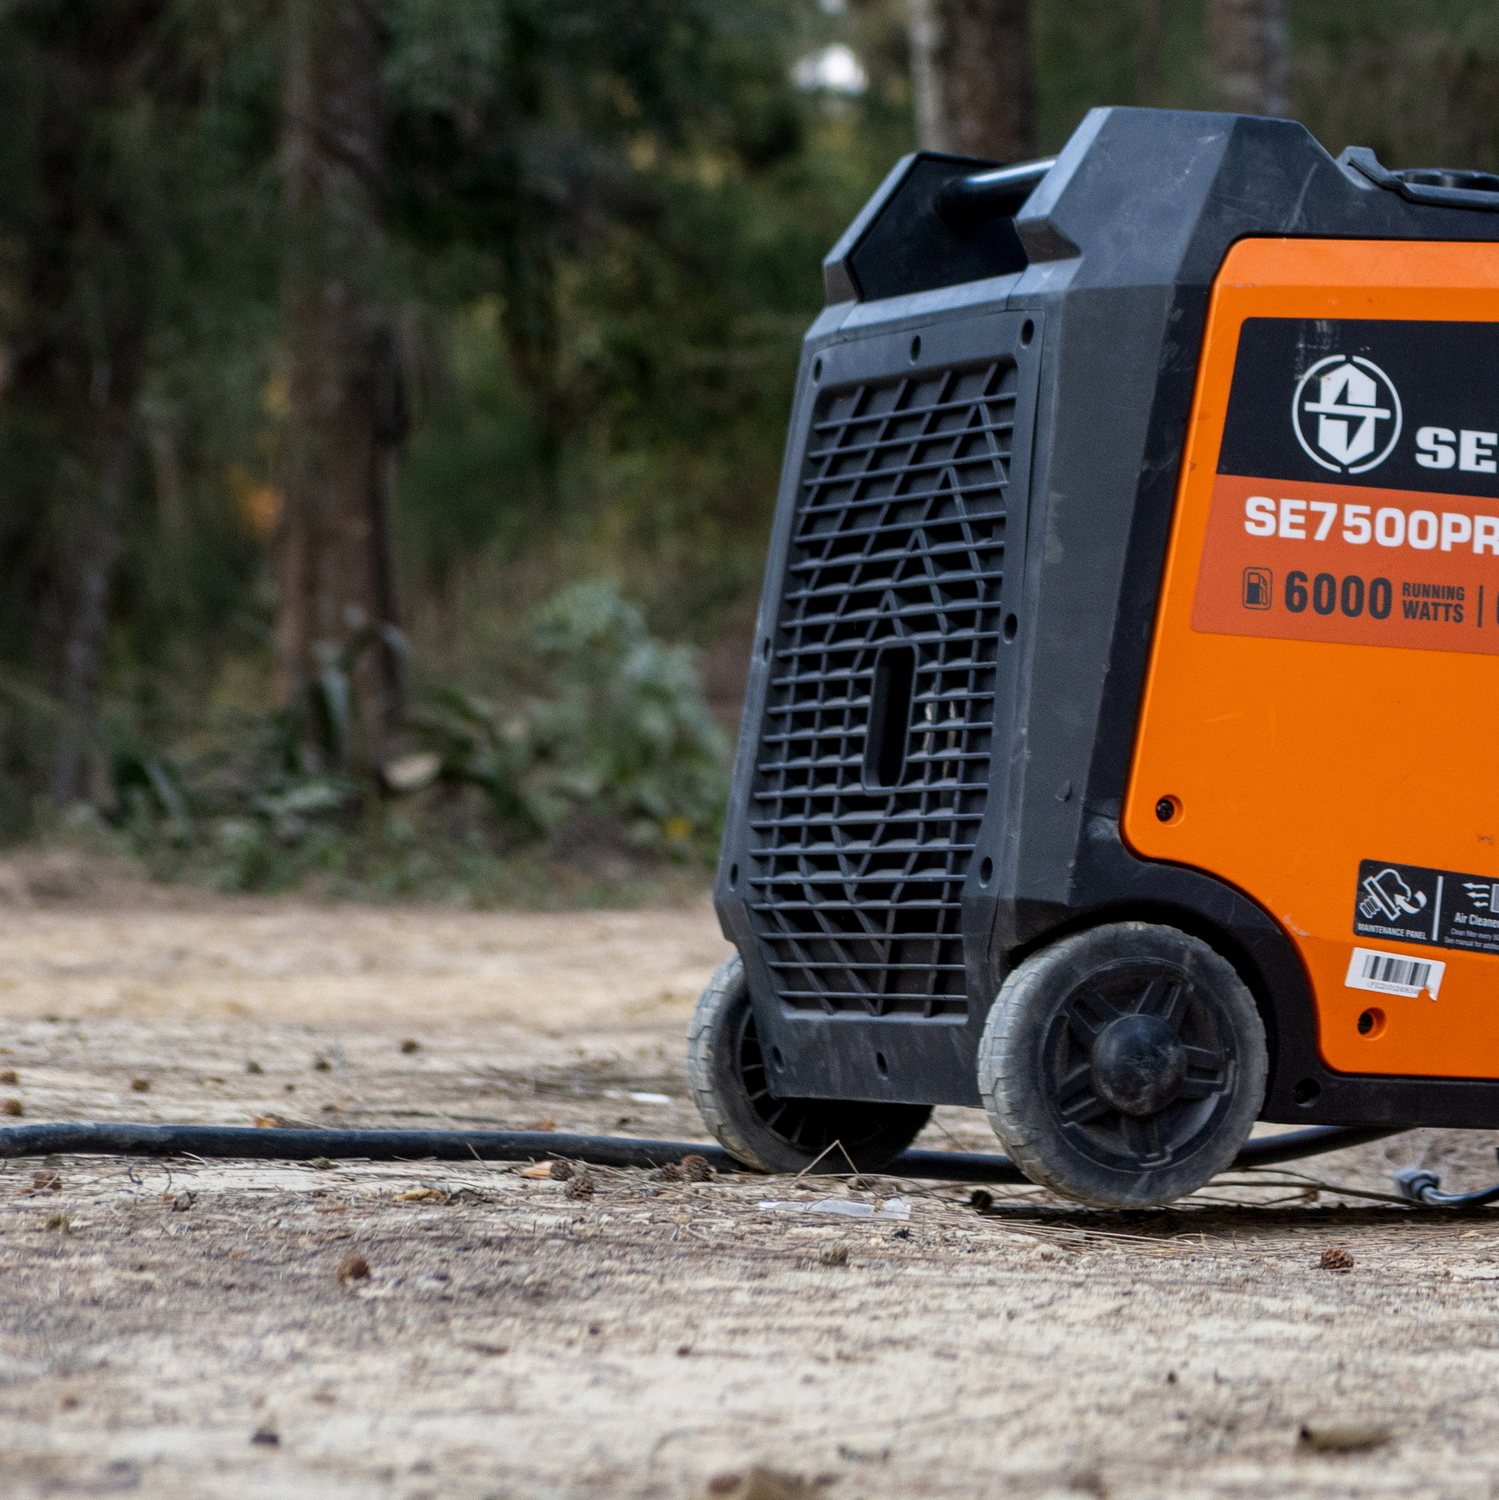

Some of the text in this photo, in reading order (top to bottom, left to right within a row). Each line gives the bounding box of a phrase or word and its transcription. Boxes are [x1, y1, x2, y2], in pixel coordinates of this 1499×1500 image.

[1284, 570, 1393, 620] 6000
[1402, 581, 1465, 602] RUNNING
[1402, 599, 1464, 623] WATTS
[1454, 912, 1468, 924] Air
[1357, 923, 1428, 941] MAINTENANCE PANEL
